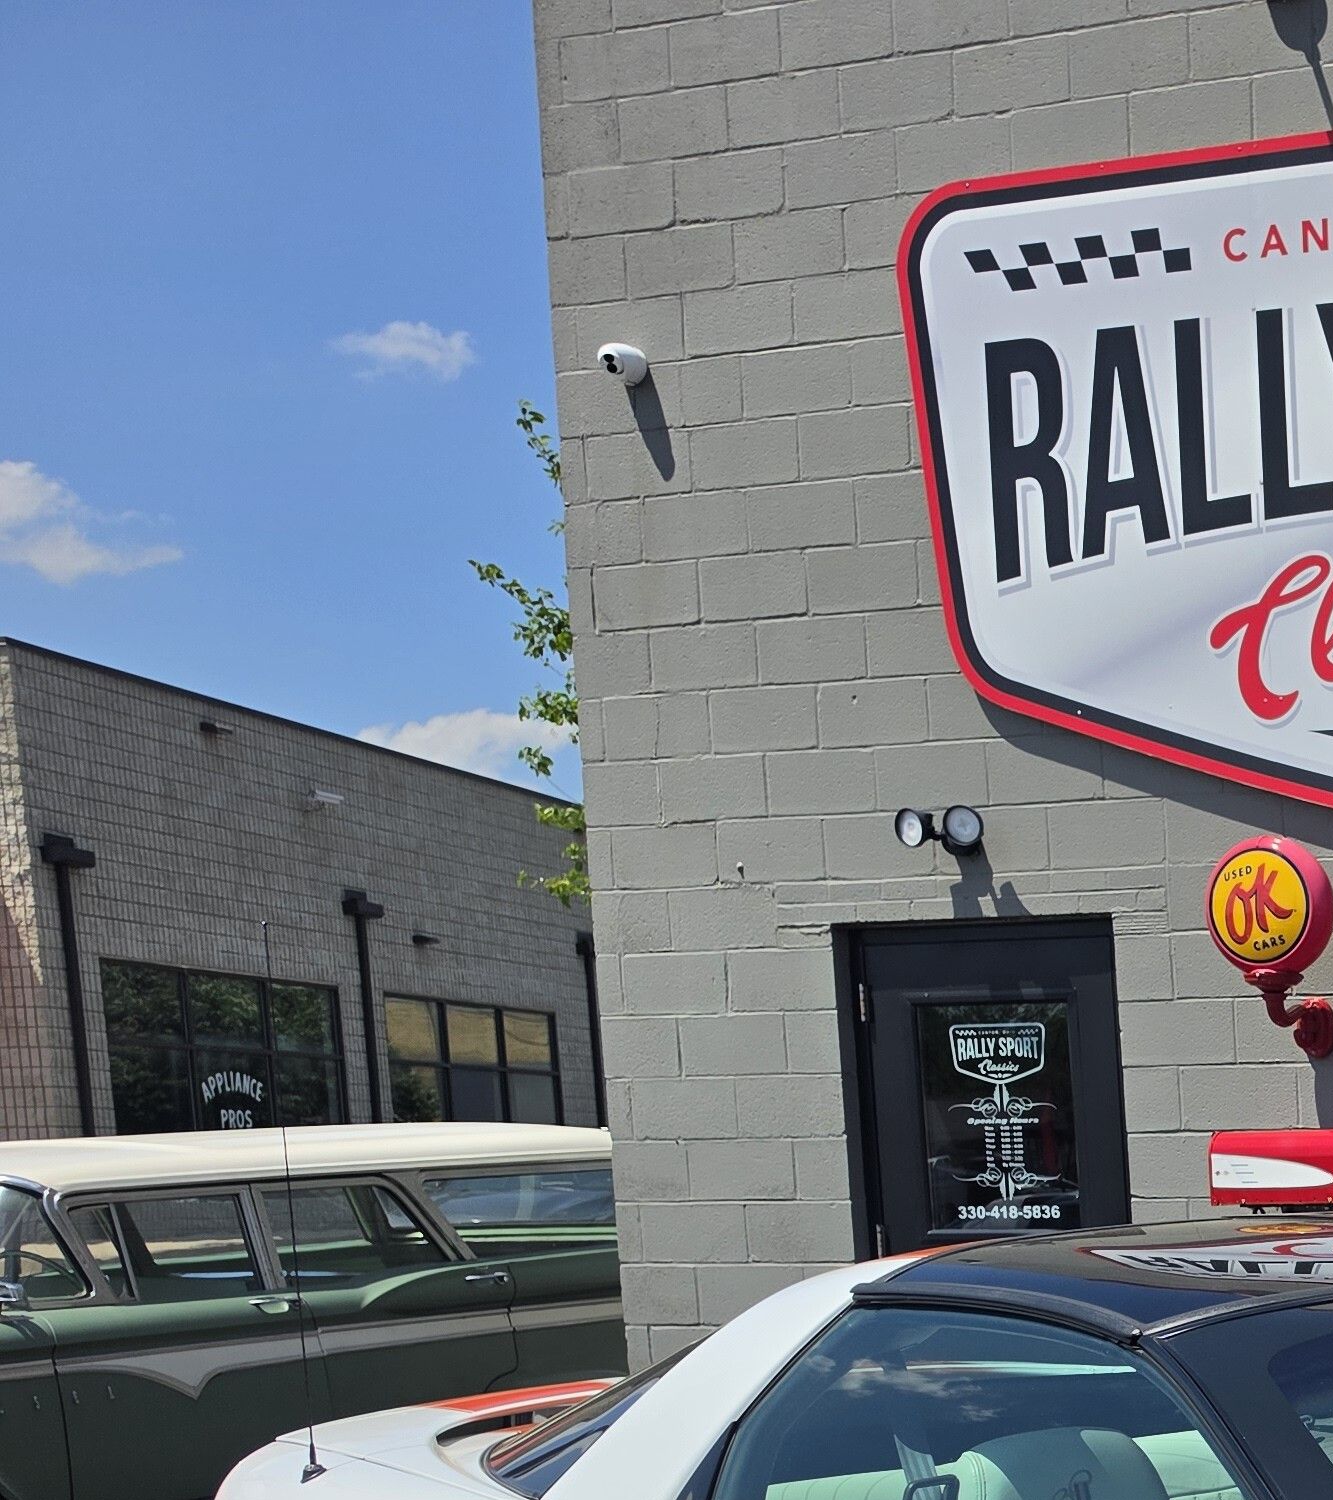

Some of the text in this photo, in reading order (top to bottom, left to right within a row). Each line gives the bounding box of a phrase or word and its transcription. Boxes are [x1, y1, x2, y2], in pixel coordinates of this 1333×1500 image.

[1224, 865, 1252, 882] USED
[1225, 862, 1294, 945] OK
[1253, 934, 1286, 951] CARS
[957, 1036, 1039, 1062] RALLY SPORT
[201, 1070, 264, 1105] APPLIANCE
[220, 1109, 253, 1129] PROS
[957, 1204, 1061, 1219] 330-418-5836
